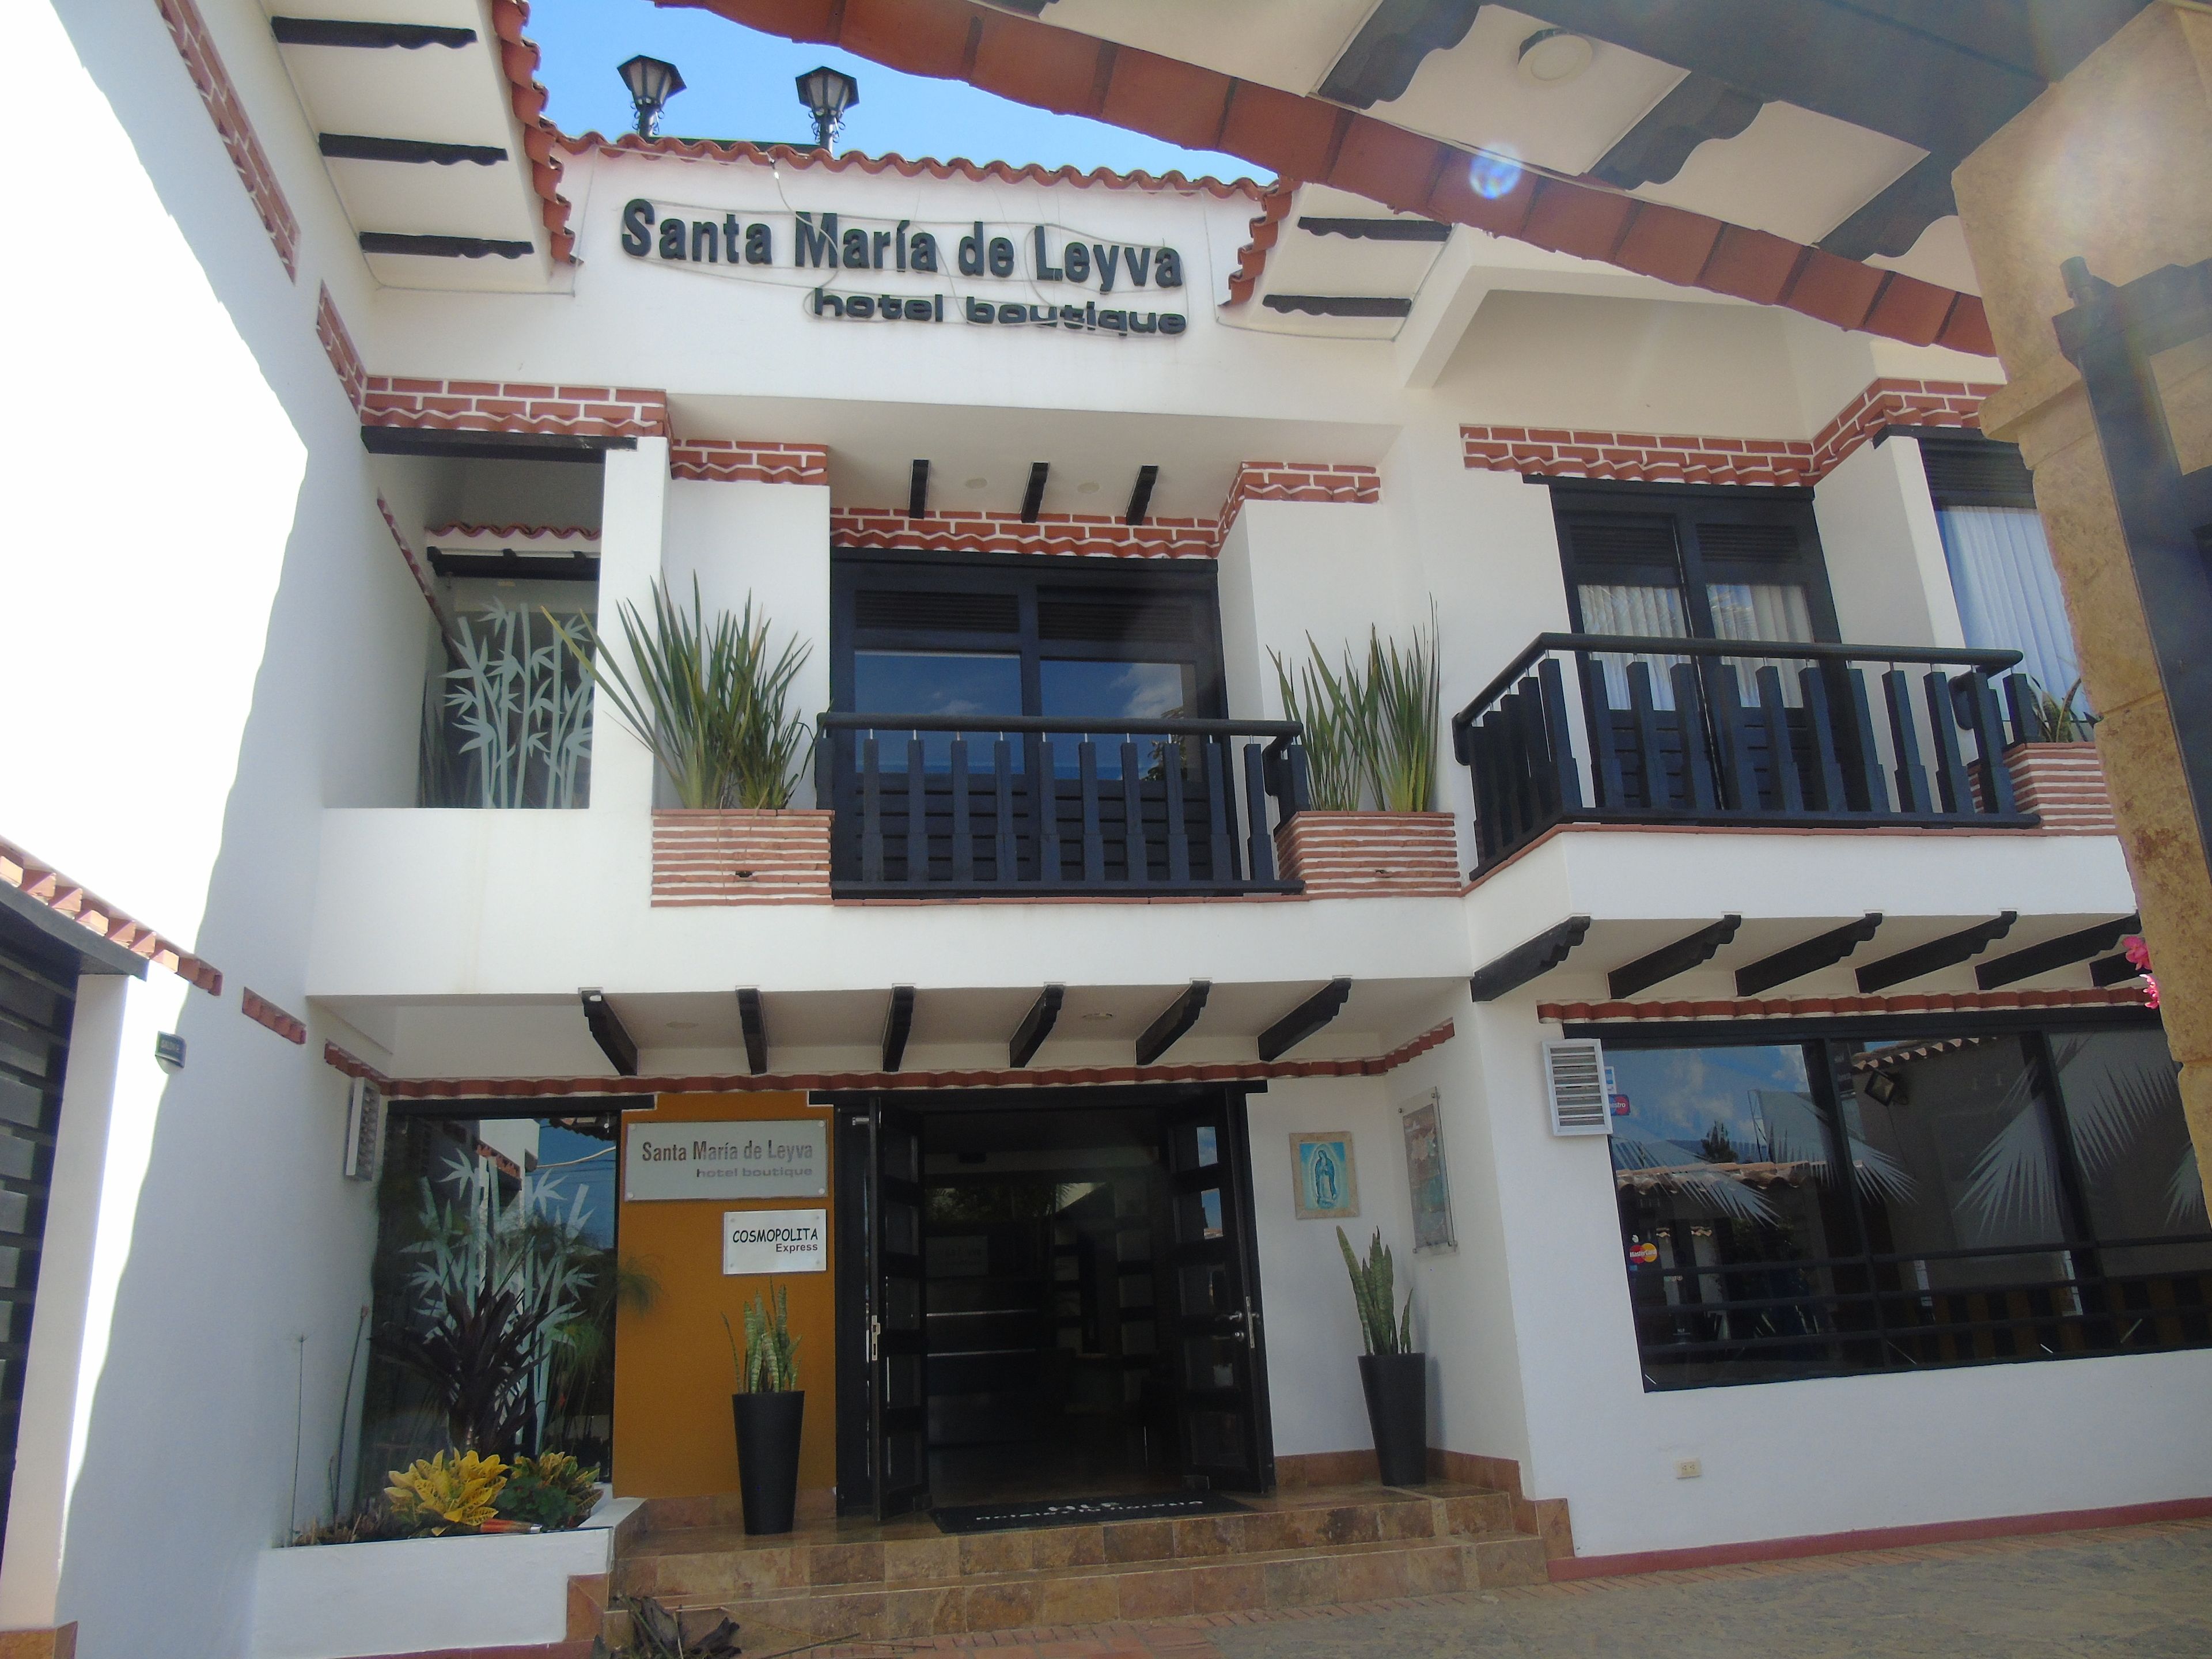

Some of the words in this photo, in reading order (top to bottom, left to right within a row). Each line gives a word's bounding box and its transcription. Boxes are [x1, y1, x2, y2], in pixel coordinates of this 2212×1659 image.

[622, 198, 773, 264] Santa
[796, 211, 937, 272] María
[959, 221, 1014, 277] de
[1035, 225, 1183, 294] Leyva
[814, 287, 944, 323] hotel
[966, 296, 1187, 336] boutique
[642, 1142, 687, 1161] Santa
[693, 1141, 738, 1160] María
[744, 1141, 762, 1160] de
[768, 1140, 813, 1162] Leyva
[696, 1168, 738, 1178] hotel
[743, 1166, 813, 1179] boutique
[733, 1228, 819, 1243] COSMOPOLITA
[776, 1243, 818, 1254] Express
